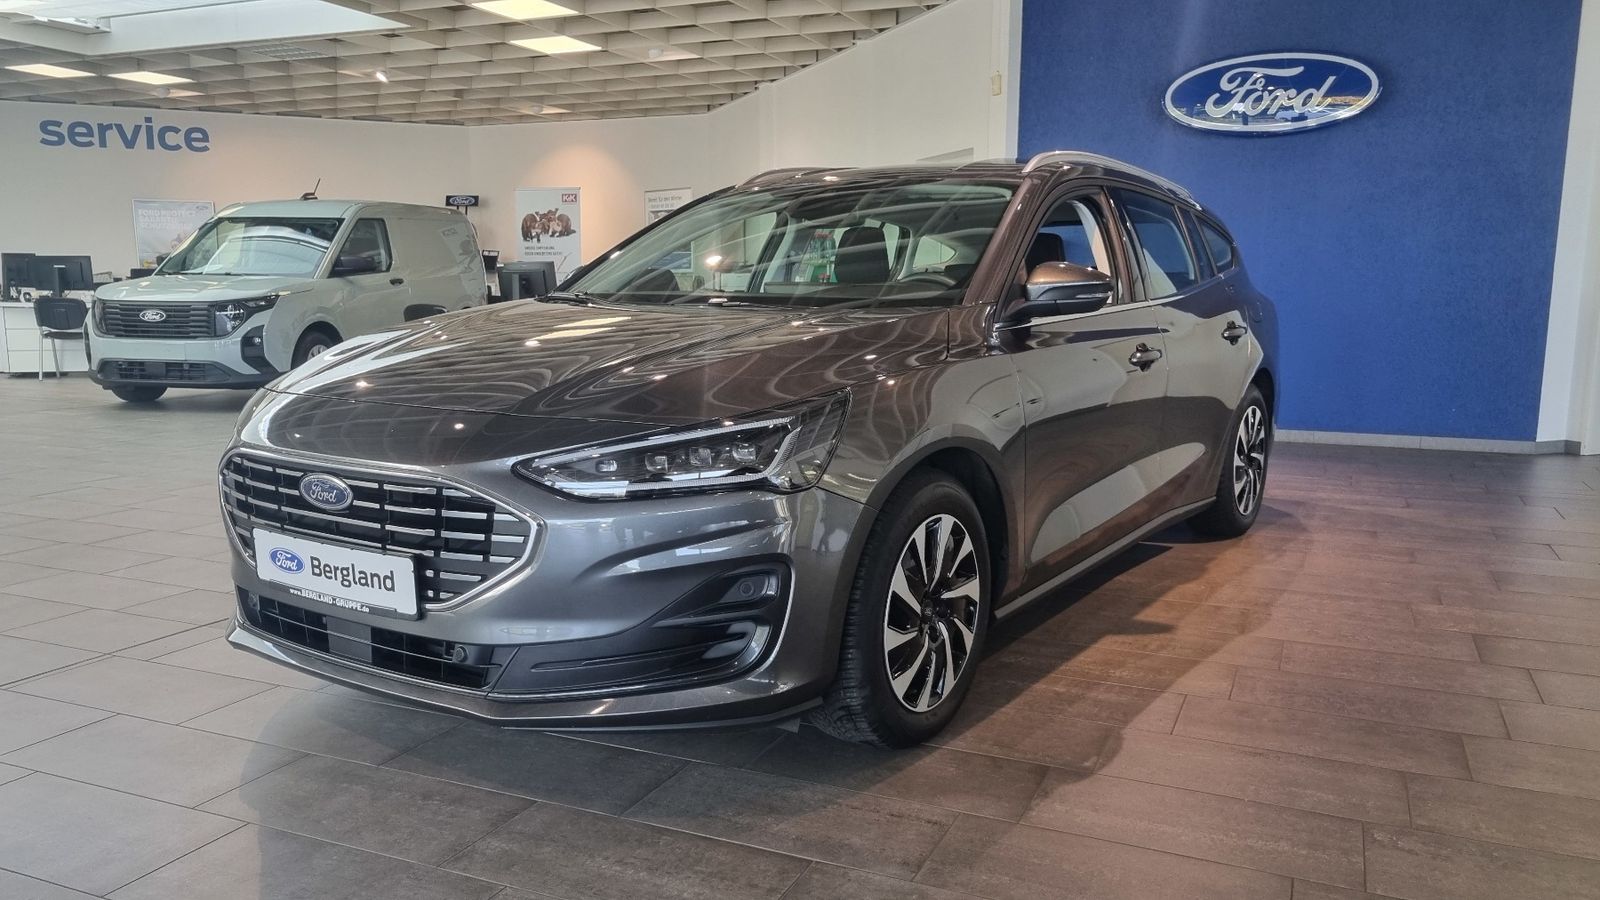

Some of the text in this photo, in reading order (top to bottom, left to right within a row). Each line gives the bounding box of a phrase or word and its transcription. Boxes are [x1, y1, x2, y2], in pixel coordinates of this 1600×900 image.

[1204, 66, 1337, 118] Ford
[39, 116, 211, 153] service
[309, 481, 337, 503] Ford
[275, 550, 396, 592] Ford Bergland
